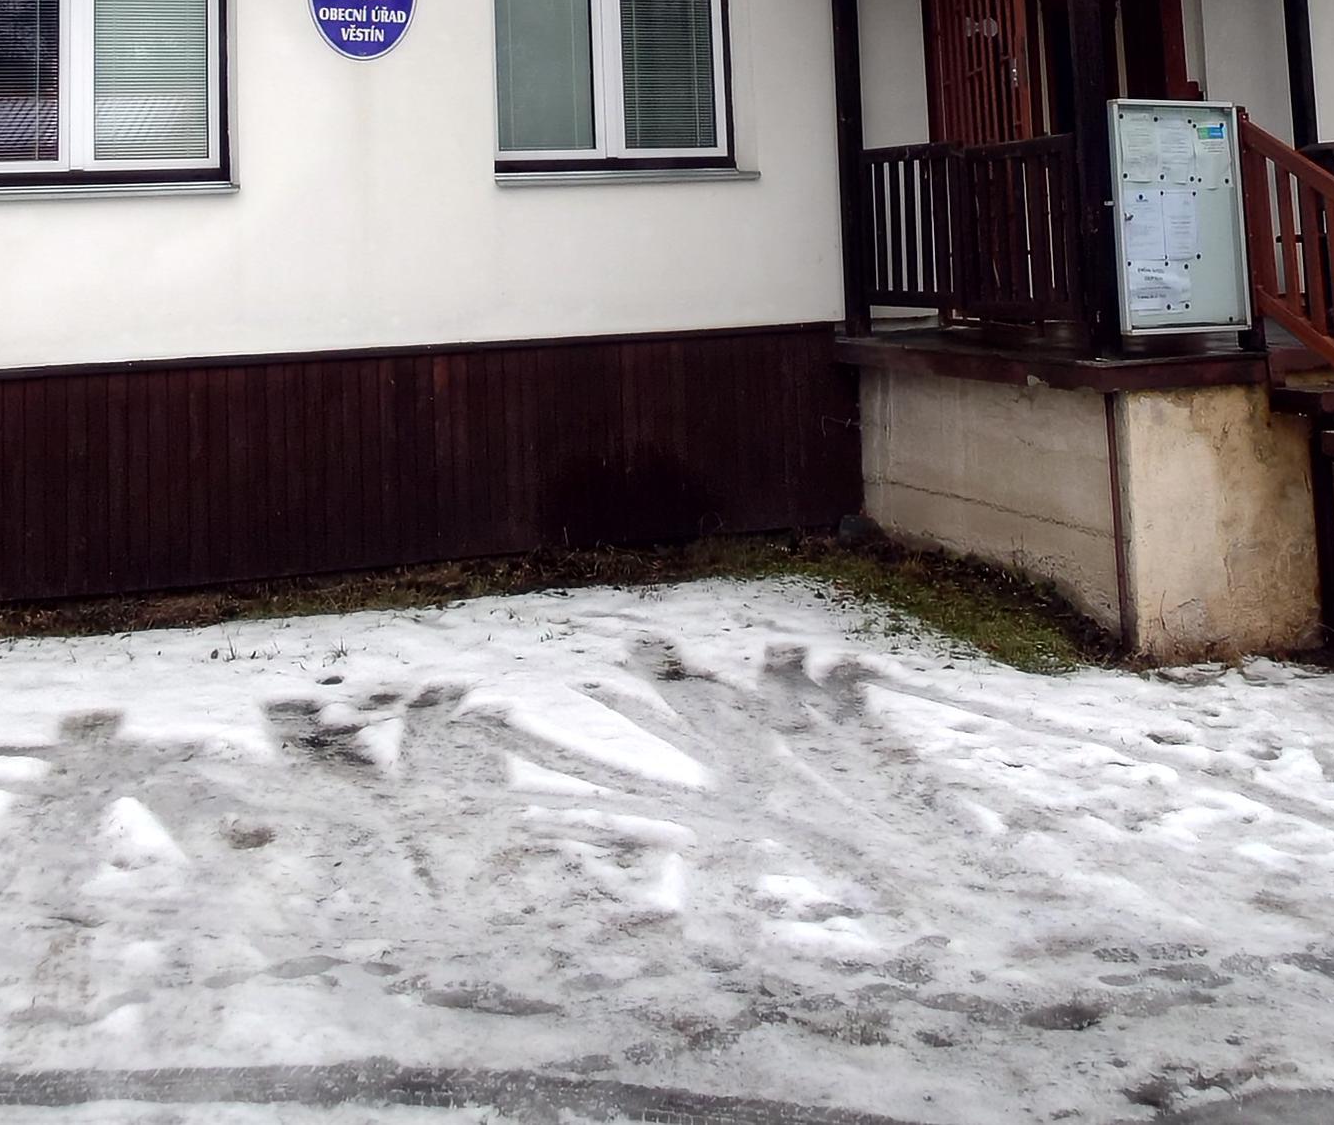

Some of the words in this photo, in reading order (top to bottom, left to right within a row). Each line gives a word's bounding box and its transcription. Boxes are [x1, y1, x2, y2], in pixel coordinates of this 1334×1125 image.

[319, 6, 366, 22] OBECNÍ
[371, 6, 406, 23] ÚŘAD
[341, 24, 384, 42] VĚSTÍN
